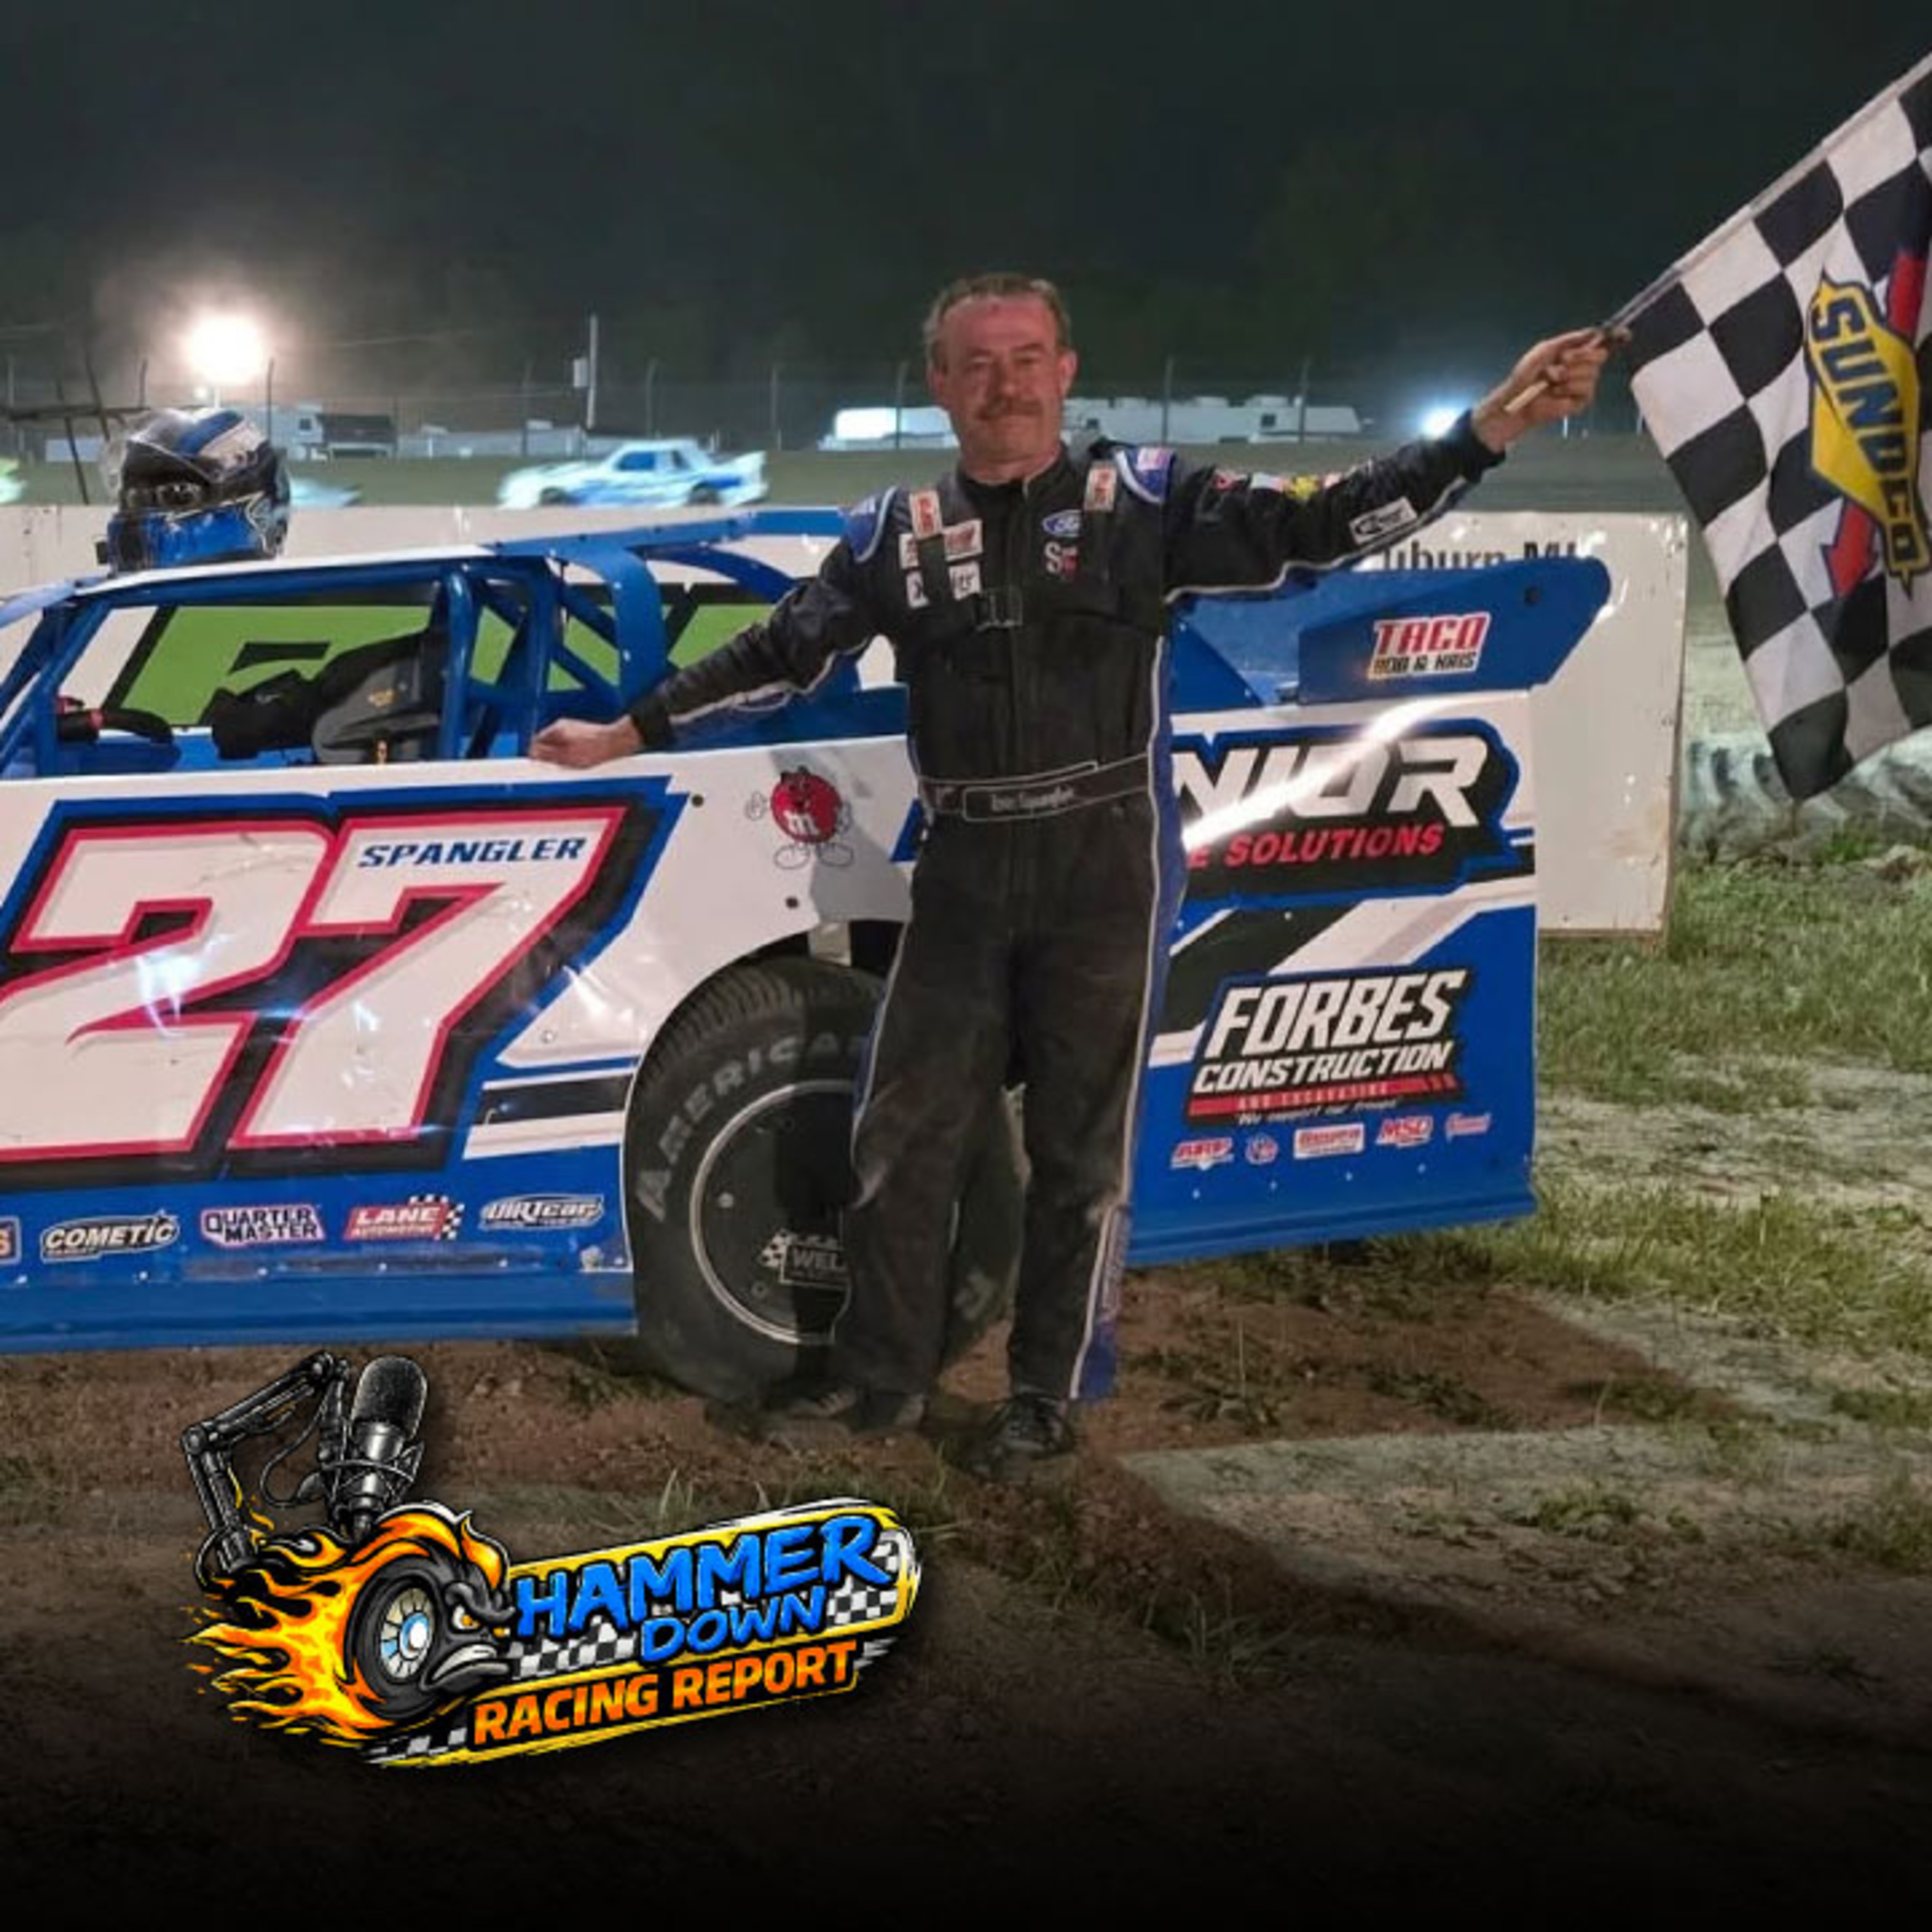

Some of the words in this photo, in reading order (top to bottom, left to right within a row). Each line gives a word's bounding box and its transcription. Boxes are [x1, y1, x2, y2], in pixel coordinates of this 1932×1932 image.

[1811, 295, 1920, 563] SUNOCO
[1384, 542, 1505, 569] uburn
[1378, 617, 1487, 656] TACO
[357, 837, 587, 867] SPANGLER
[1225, 822, 1445, 869] SOLUTIONS
[0, 808, 627, 1159] 27
[1204, 970, 1467, 1059] FORBES
[1193, 1040, 1455, 1094] CONSTRUCTION
[204, 1208, 313, 1233] QUARTER
[225, 1222, 318, 1243] MASTER
[355, 1206, 442, 1225] LANE
[45, 1219, 174, 1249] COMETIC
